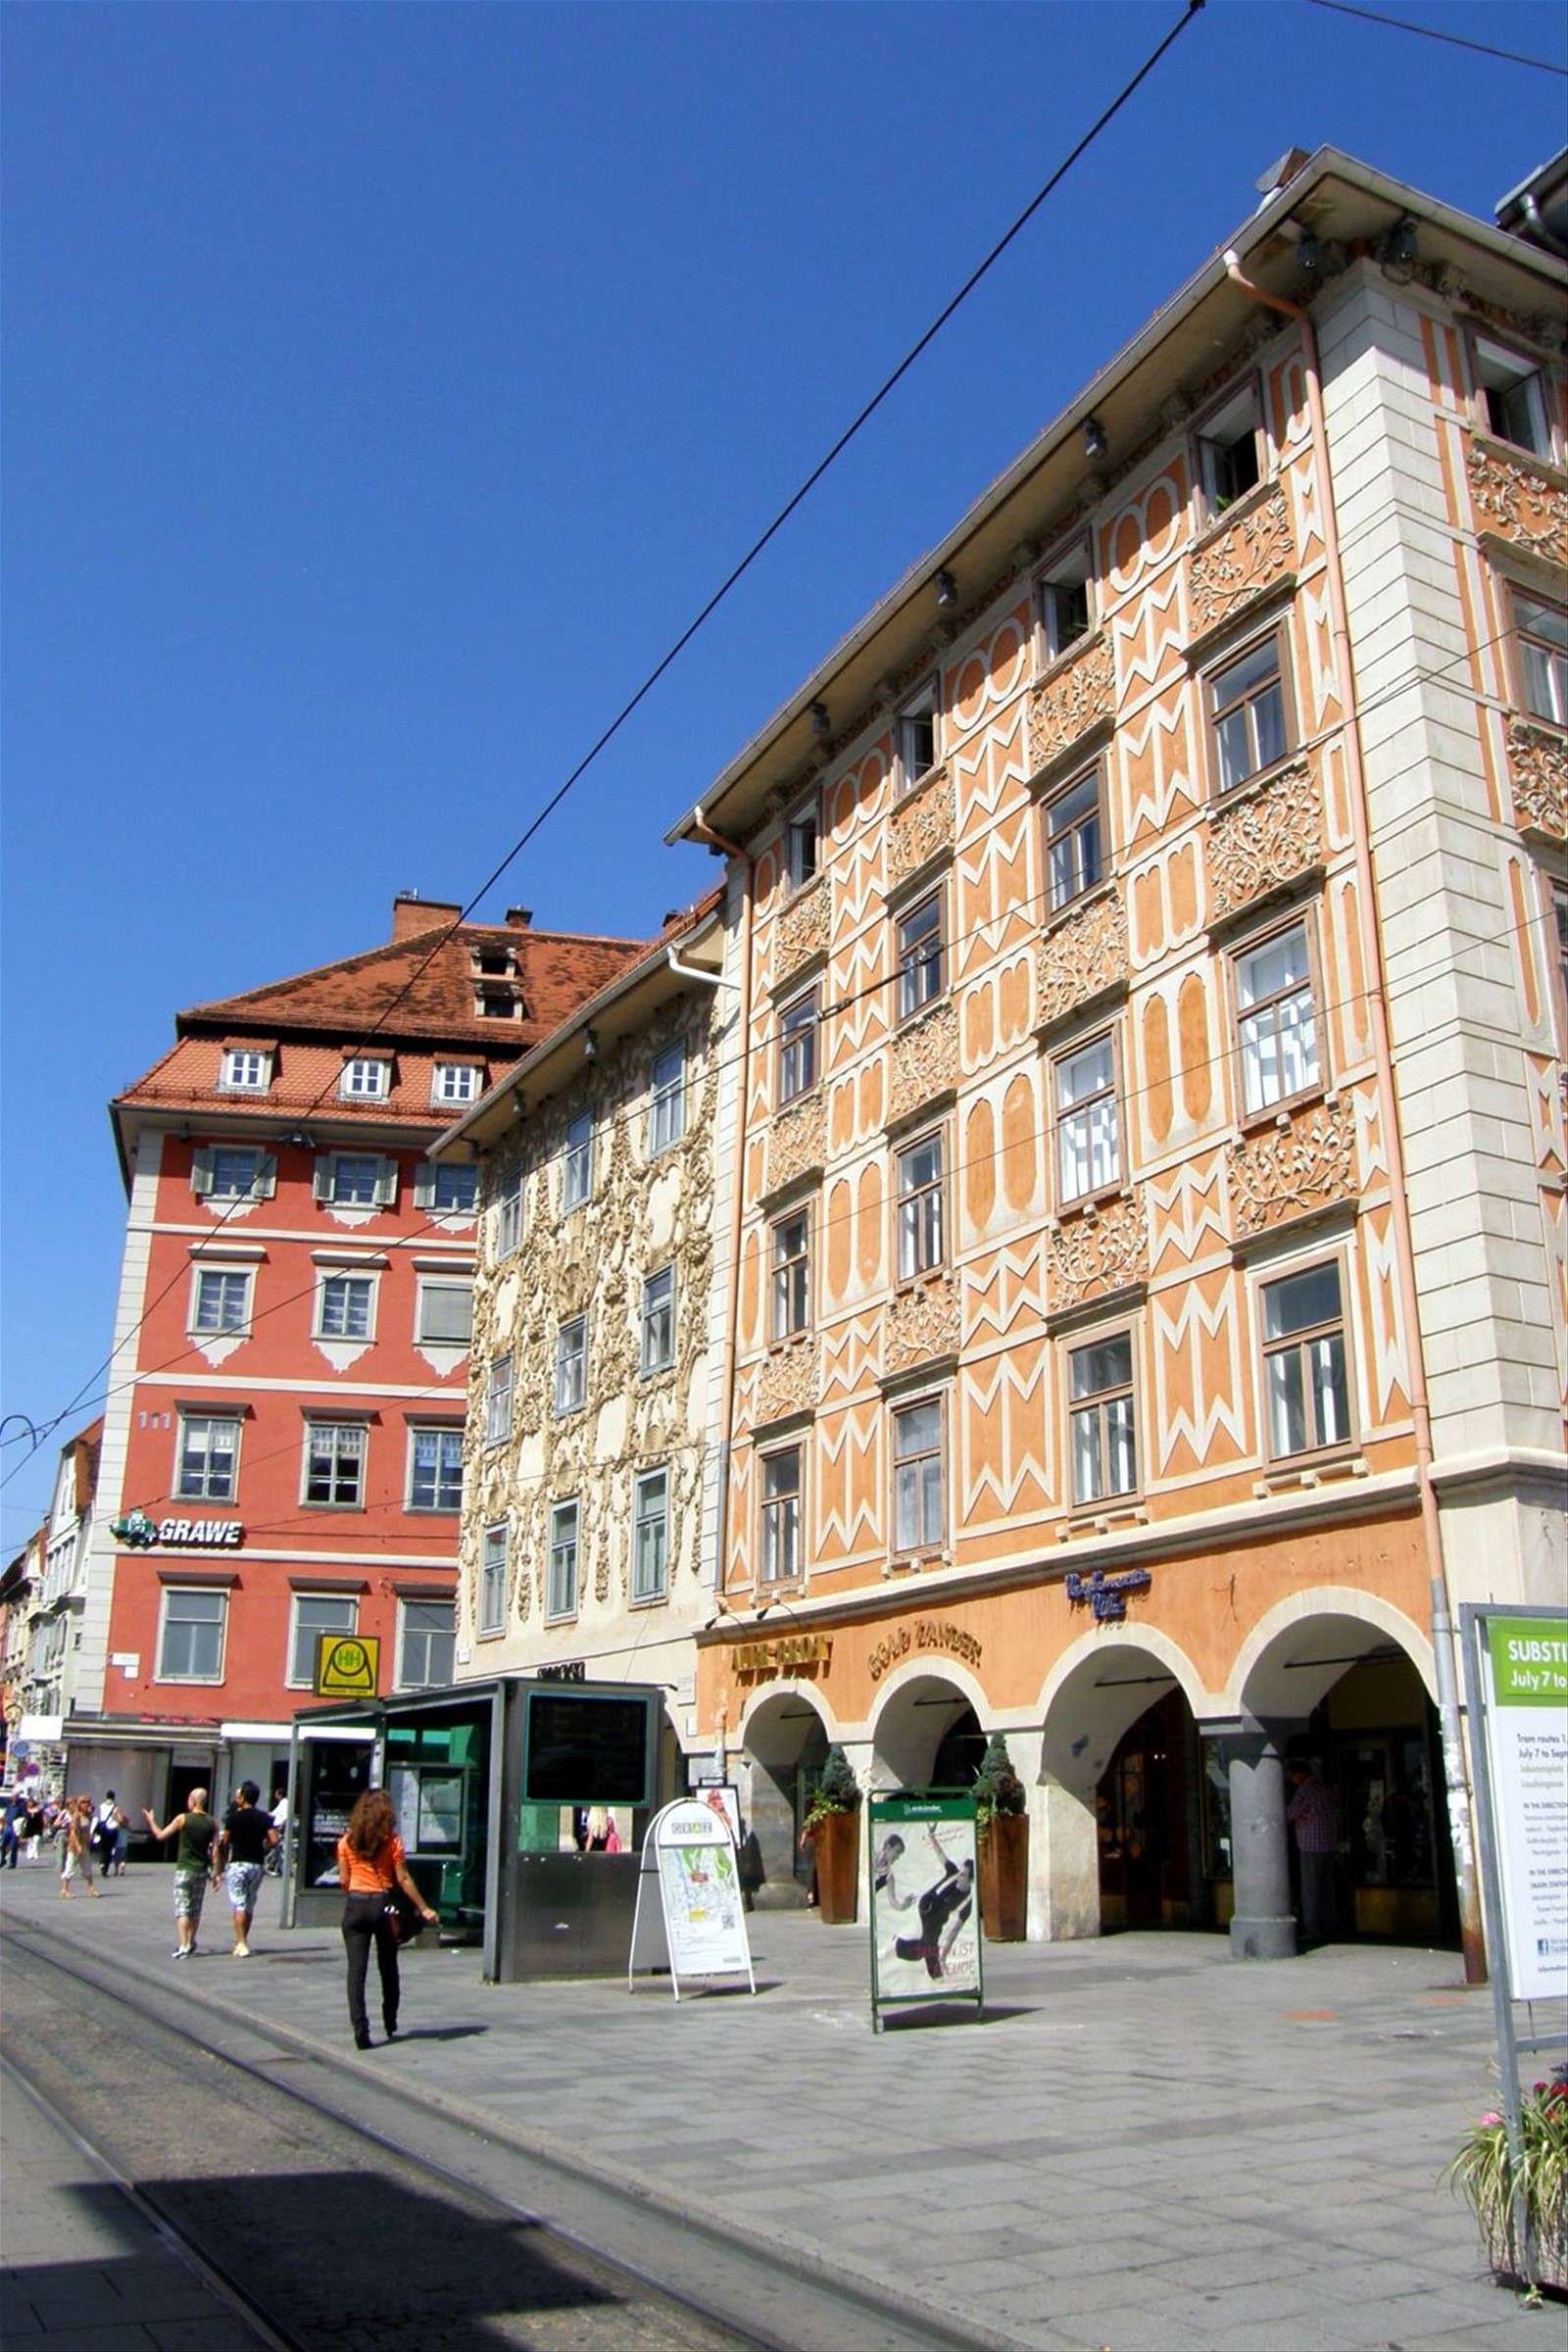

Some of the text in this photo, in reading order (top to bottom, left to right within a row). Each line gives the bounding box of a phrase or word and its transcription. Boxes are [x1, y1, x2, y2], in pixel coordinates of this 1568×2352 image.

[159, 1519, 242, 1544] GRAWE
[1507, 1639, 1568, 1663] SUBSTI
[1510, 1669, 1567, 1691] July 7 to
[1518, 1747, 1533, 1761] July
